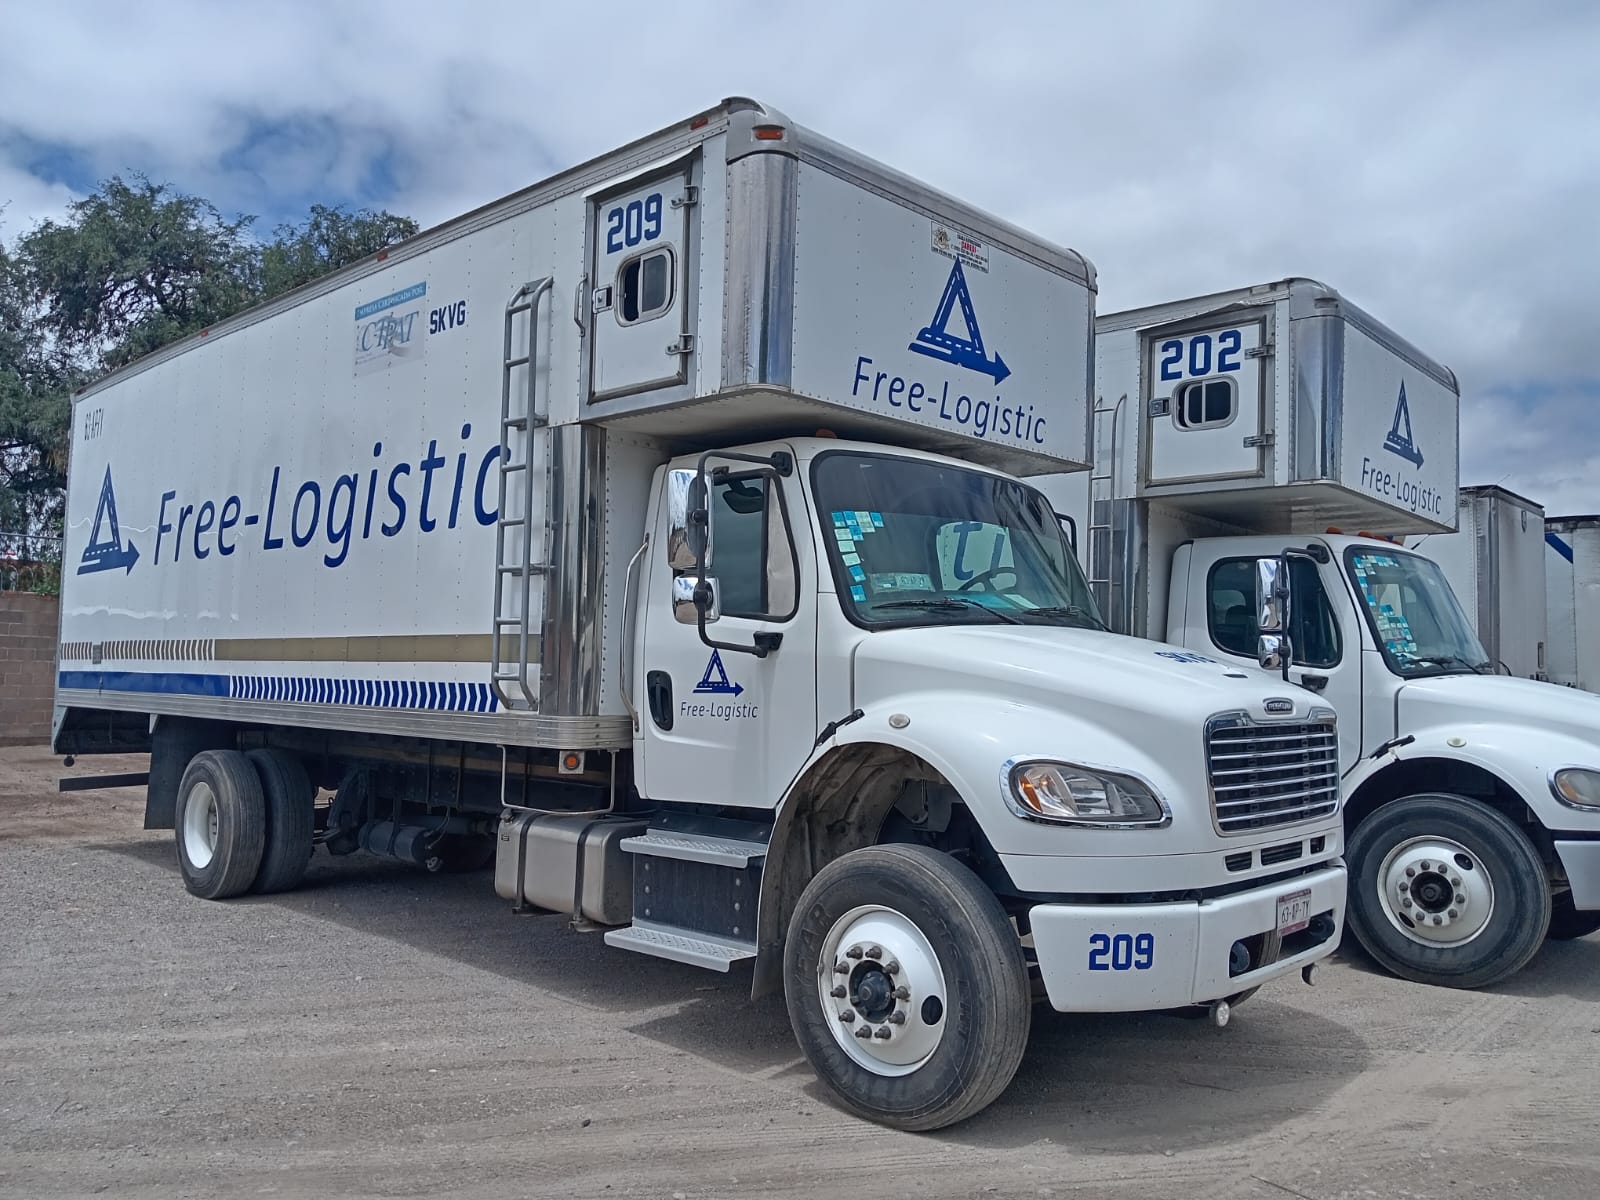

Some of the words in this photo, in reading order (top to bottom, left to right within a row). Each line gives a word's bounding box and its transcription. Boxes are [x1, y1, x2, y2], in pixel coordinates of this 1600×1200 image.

[606, 192, 662, 254] 209
[430, 300, 466, 335] SKVG
[1160, 330, 1242, 381] 202
[852, 356, 1046, 444] Free-Logistic
[154, 422, 511, 568] Free-Logistic
[1362, 458, 1442, 514] Free-Logistic
[680, 701, 759, 722] Free-Logistic
[1088, 933, 1154, 971] 209
